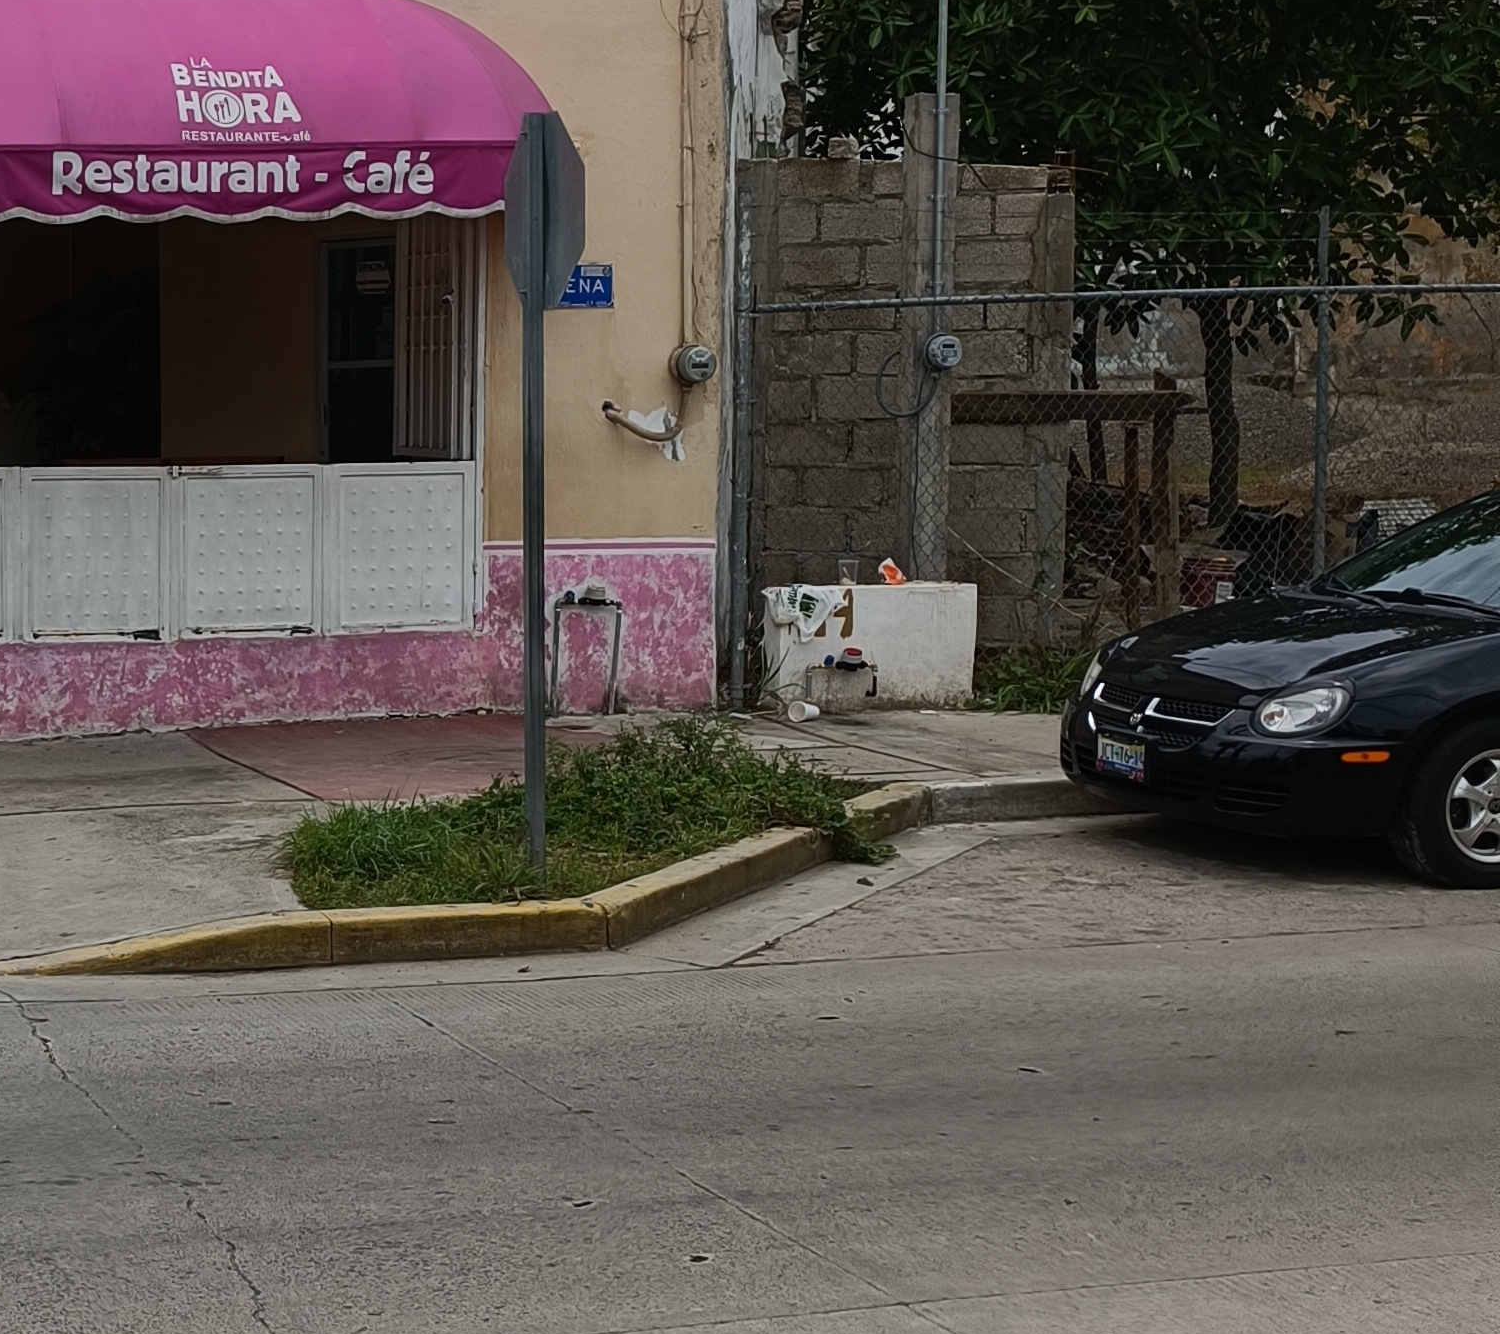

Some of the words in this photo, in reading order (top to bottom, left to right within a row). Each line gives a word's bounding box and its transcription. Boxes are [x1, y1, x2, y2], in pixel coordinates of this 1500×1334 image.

[190, 56, 212, 68] LA
[170, 63, 284, 88] BENDITA
[175, 90, 302, 128] HORA
[51, 151, 301, 196] Restaurant
[343, 150, 434, 195] Café
[566, 278, 605, 294] ENA
